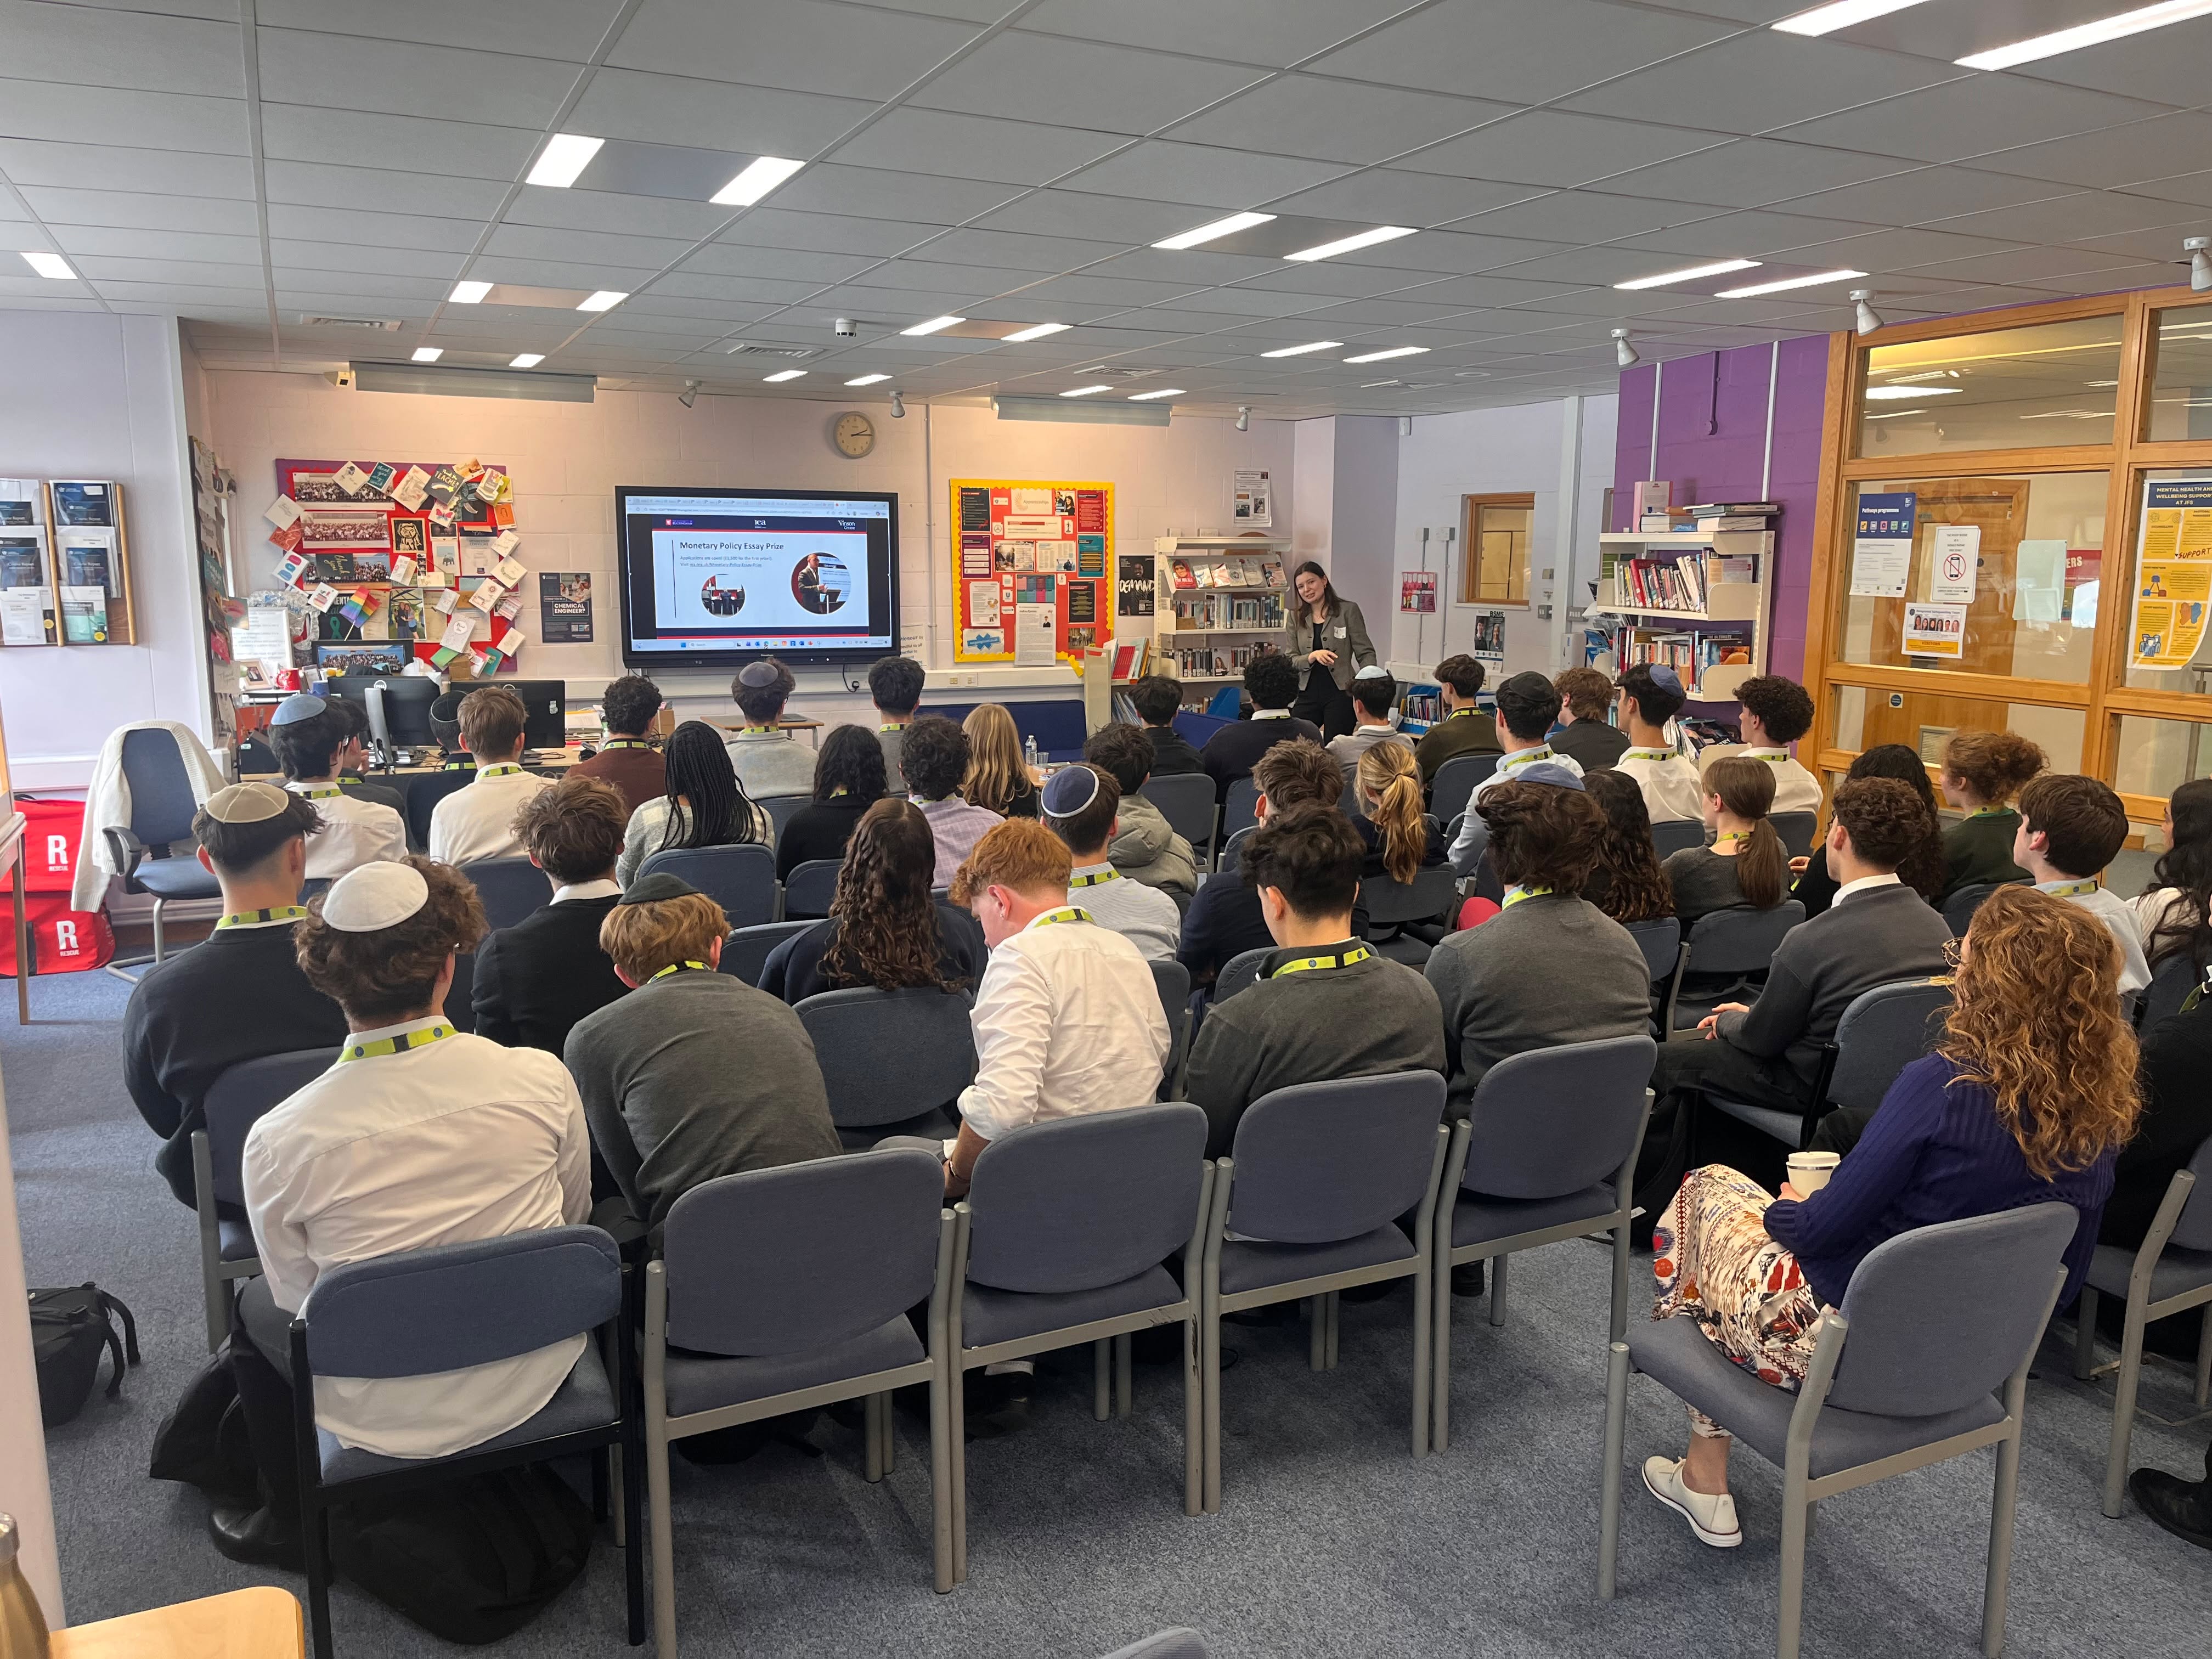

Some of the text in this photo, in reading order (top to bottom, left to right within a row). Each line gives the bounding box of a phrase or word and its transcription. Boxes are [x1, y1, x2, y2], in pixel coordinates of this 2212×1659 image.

[435, 471, 459, 488] TEACHER
[680, 542, 718, 550] Monetary
[720, 542, 742, 551] Policy
[744, 543, 764, 551] Essay
[2178, 548, 2212, 558] SUPPORT
[1119, 579, 1154, 593] DEMAND
[48, 835, 68, 864] R
[57, 920, 78, 950] R
